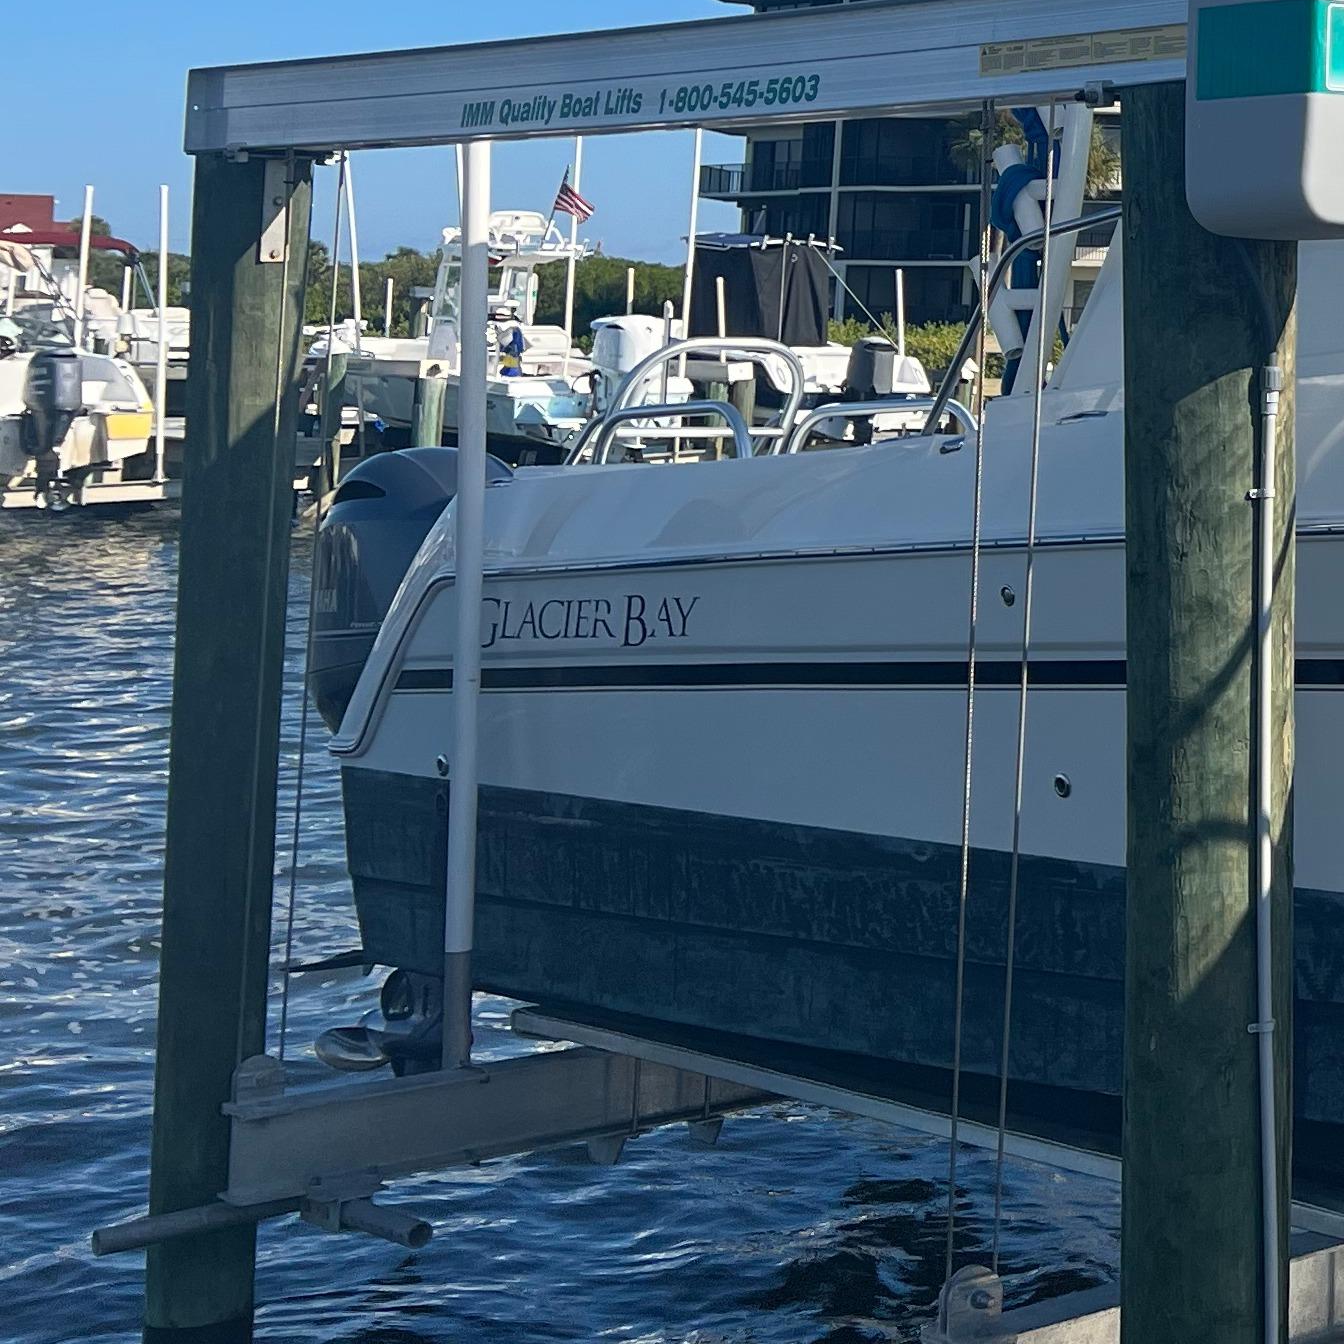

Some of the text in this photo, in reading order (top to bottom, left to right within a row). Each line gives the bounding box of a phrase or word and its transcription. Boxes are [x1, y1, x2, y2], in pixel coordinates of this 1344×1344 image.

[460, 73, 821, 128] IMM Quality Boat Lifts 1-800-545-5603
[481, 594, 701, 649] GLACIER BAY
